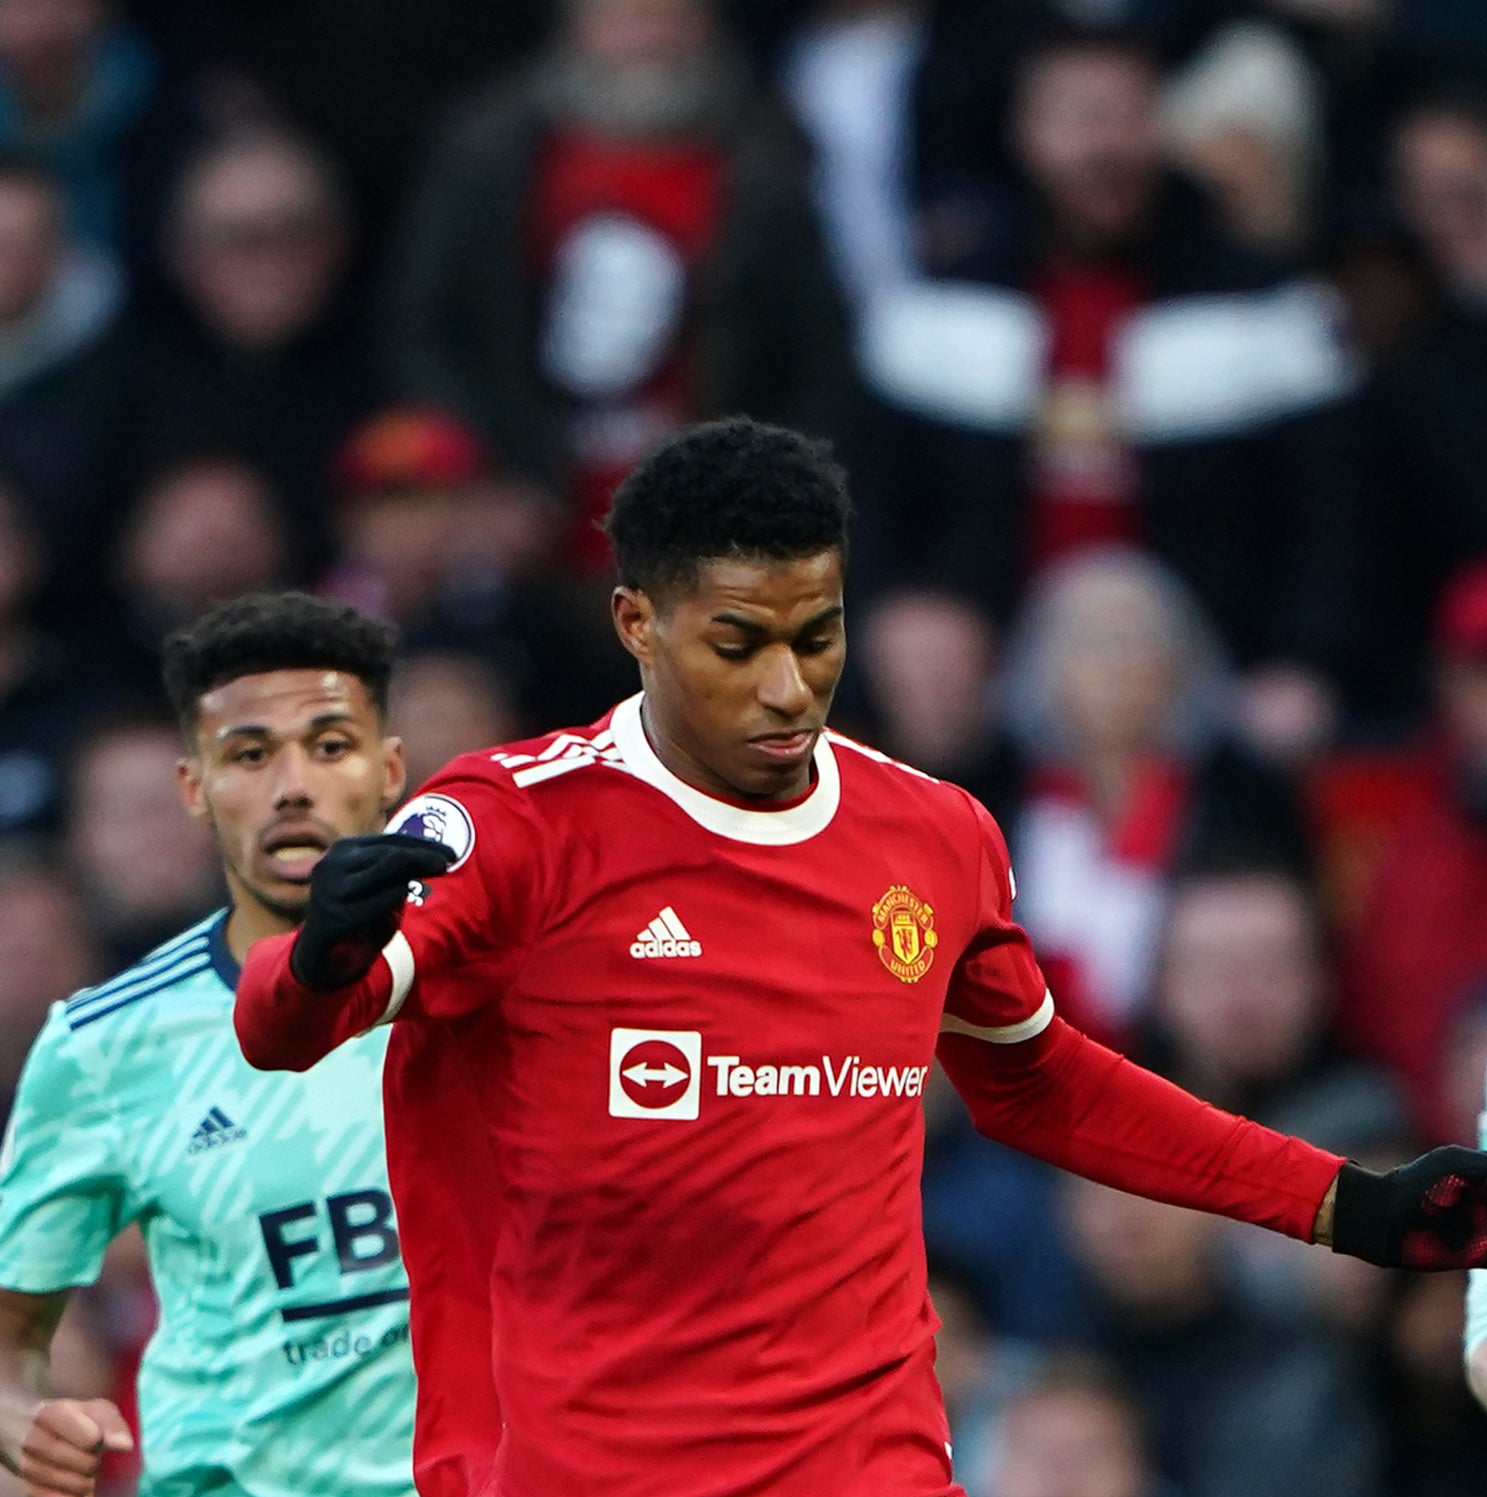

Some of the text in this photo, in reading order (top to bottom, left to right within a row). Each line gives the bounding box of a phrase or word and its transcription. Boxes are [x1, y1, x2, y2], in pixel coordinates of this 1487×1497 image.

[876, 893, 929, 924] MANCHESTER
[629, 939, 702, 959] adidas
[707, 1055, 928, 1098] TeamViewer
[259, 1188, 402, 1290] FB
